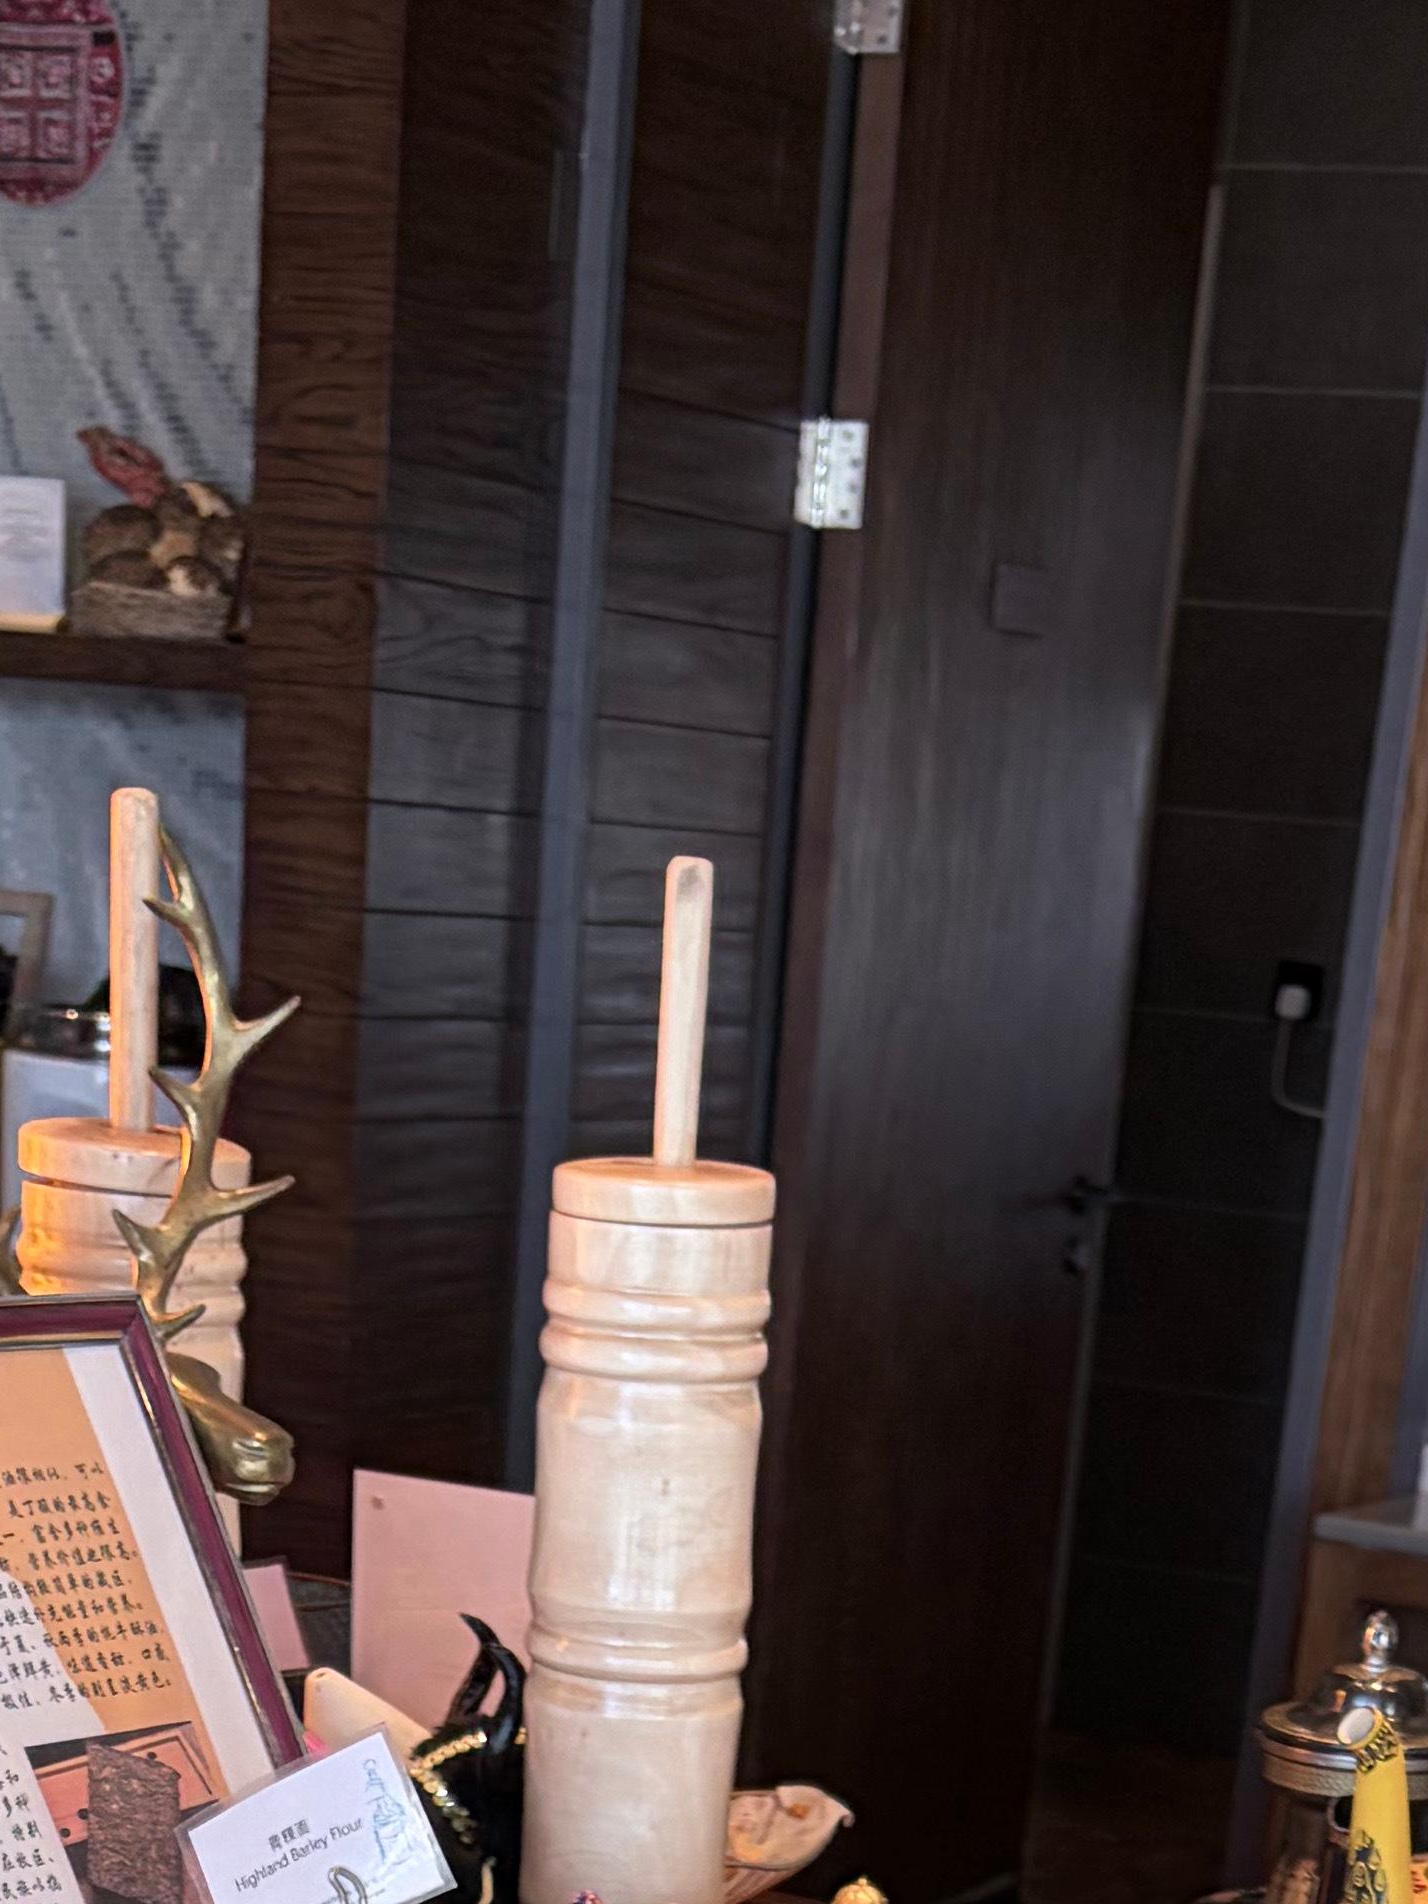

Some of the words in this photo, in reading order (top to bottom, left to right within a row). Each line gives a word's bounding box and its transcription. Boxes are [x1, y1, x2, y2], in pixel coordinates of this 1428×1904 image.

[235, 1856, 289, 1892] Highland
[291, 1833, 328, 1863] Barley
[329, 1818, 362, 1841] Flour
